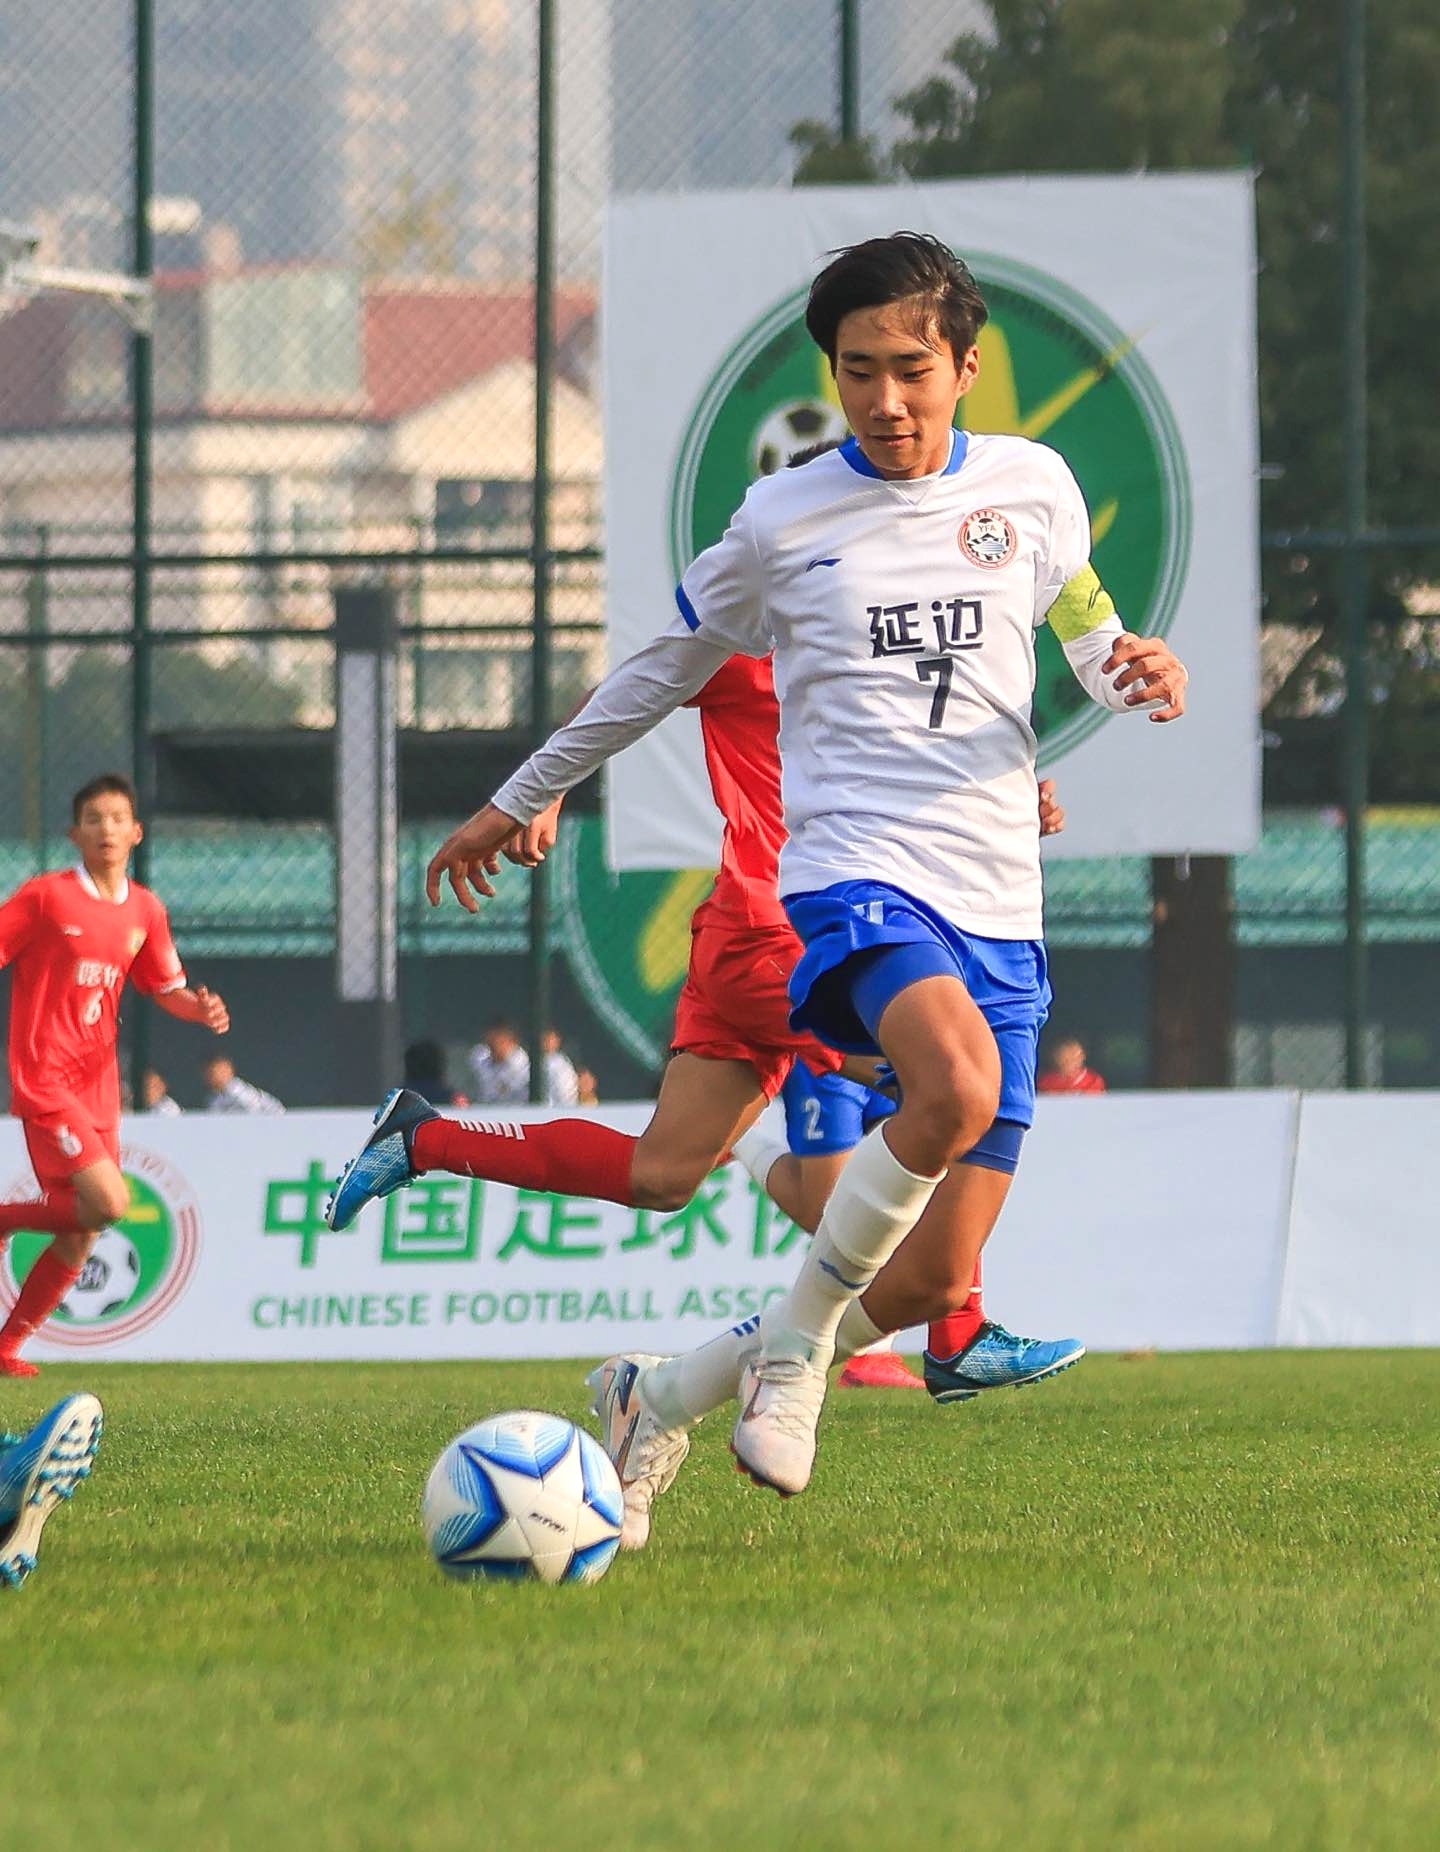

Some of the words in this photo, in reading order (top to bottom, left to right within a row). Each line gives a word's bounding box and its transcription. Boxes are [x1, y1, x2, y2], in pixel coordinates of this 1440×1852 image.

[866, 599, 985, 658] 延边
[916, 657, 954, 730] 7
[83, 990, 105, 1026] 6
[801, 1097, 824, 1140] 2
[252, 1291, 431, 1329] CHINESE
[446, 1286, 662, 1326] FOOTBALL
